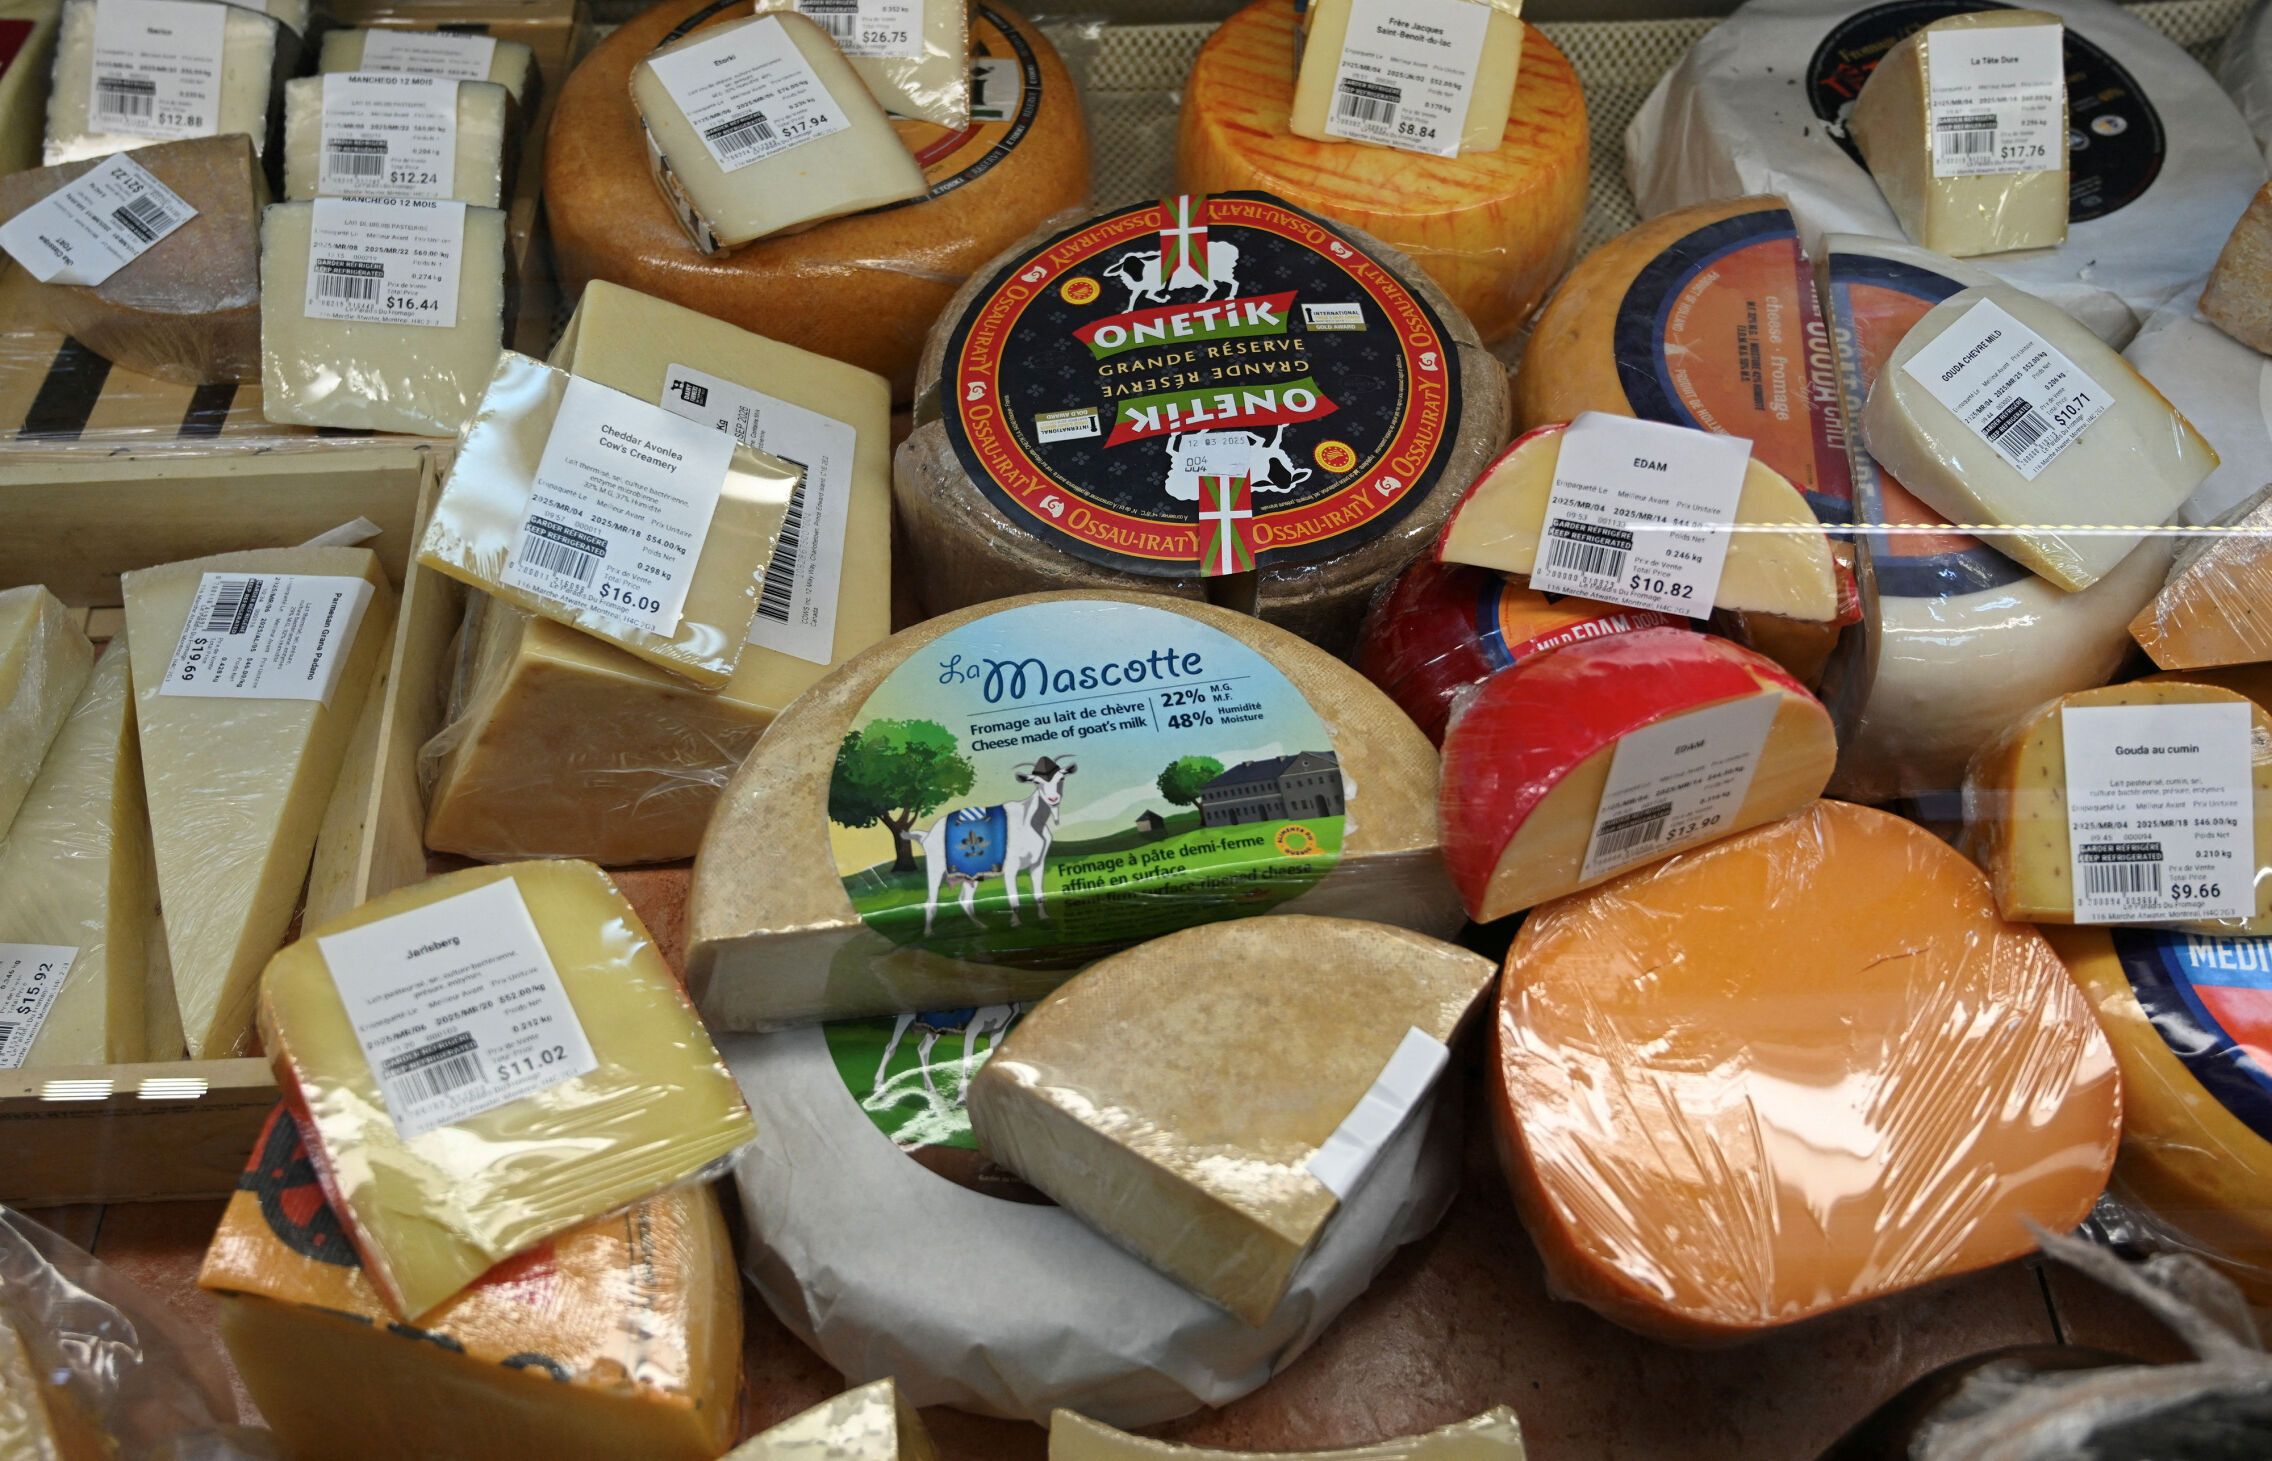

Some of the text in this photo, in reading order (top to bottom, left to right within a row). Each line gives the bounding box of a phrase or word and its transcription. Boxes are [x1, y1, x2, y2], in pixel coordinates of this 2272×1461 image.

[862, 31, 907, 43] $26.75
[1388, 17, 1444, 35] Frère Jacques
[713, 54, 736, 66] Etorki
[1982, 56, 1998, 64] Tête
[348, 76, 434, 86] MANCHEGO 12 MOIS
[781, 114, 827, 137] $17.94
[1397, 122, 1435, 138] $8.84
[2001, 144, 2044, 158] $17.76
[111, 167, 144, 194] $21.22
[390, 171, 438, 184] $12.24
[342, 195, 437, 209] MANCHEGO 12 MOIS
[386, 296, 439, 312] $16.44
[1098, 338, 1305, 377] GRANDE RÉSERVE
[1766, 295, 1791, 422] cheese fromage
[1941, 329, 2001, 381] GOUDA CHEVRE MILD
[1102, 360, 1310, 398] GRANDE RÉSERVE
[2054, 392, 2090, 425] $10.71
[735, 404, 748, 440] SEP 2026
[600, 424, 682, 461] Cheddar Avonlea
[1222, 436, 1246, 445] 2025
[598, 436, 677, 473] Cow's Creamery
[1186, 456, 1208, 466] 004
[1633, 457, 1667, 471] EDAM
[1552, 496, 1666, 522] 2025/MR/04 2025/MR/14
[529, 515, 563, 533] GARDER
[590, 514, 641, 537] 2025/MR/18
[645, 534, 686, 555] $54.00/kg
[1552, 519, 1586, 532] GARDER
[525, 523, 606, 557] KEEP REFRIGERATED
[1547, 527, 1632, 549] KEEP REFRIGERATED
[1691, 553, 1702, 563] kg
[661, 570, 671, 581] kg
[1629, 574, 1693, 599] $10.82
[599, 582, 660, 613] $16.09
[303, 592, 342, 680] Parmesan Grana Padano
[1570, 613, 1631, 641] EDAM
[181, 637, 207, 680] $19.69
[938, 648, 1204, 703] La Mascotte
[1160, 688, 1206, 708] 22%
[1210, 683, 1233, 693] M.G.
[1212, 693, 1233, 703] M.F.
[969, 701, 1145, 737] Fromage au lait de chèvre
[1217, 701, 1262, 715] Humidité
[1220, 711, 1265, 726] Moisture
[1167, 711, 1214, 730] 48%
[970, 716, 1148, 752] Cheese made of goat's milk
[1674, 739, 1705, 754] EDAM
[2115, 744, 2199, 755] Gouda au cumin
[1665, 814, 1720, 841] $13.90
[1057, 834, 1265, 877] Fromage à pâte demi-ferme
[2221, 850, 2231, 859] kg
[1061, 863, 1187, 895] affiné en surface
[1261, 863, 1313, 880] cheese
[2171, 883, 2220, 900] $9.66
[404, 934, 461, 961] Jarlsberg
[2186, 933, 2272, 973] MEDI
[15, 962, 53, 1014] $15.92
[497, 1044, 567, 1081] $11.02
